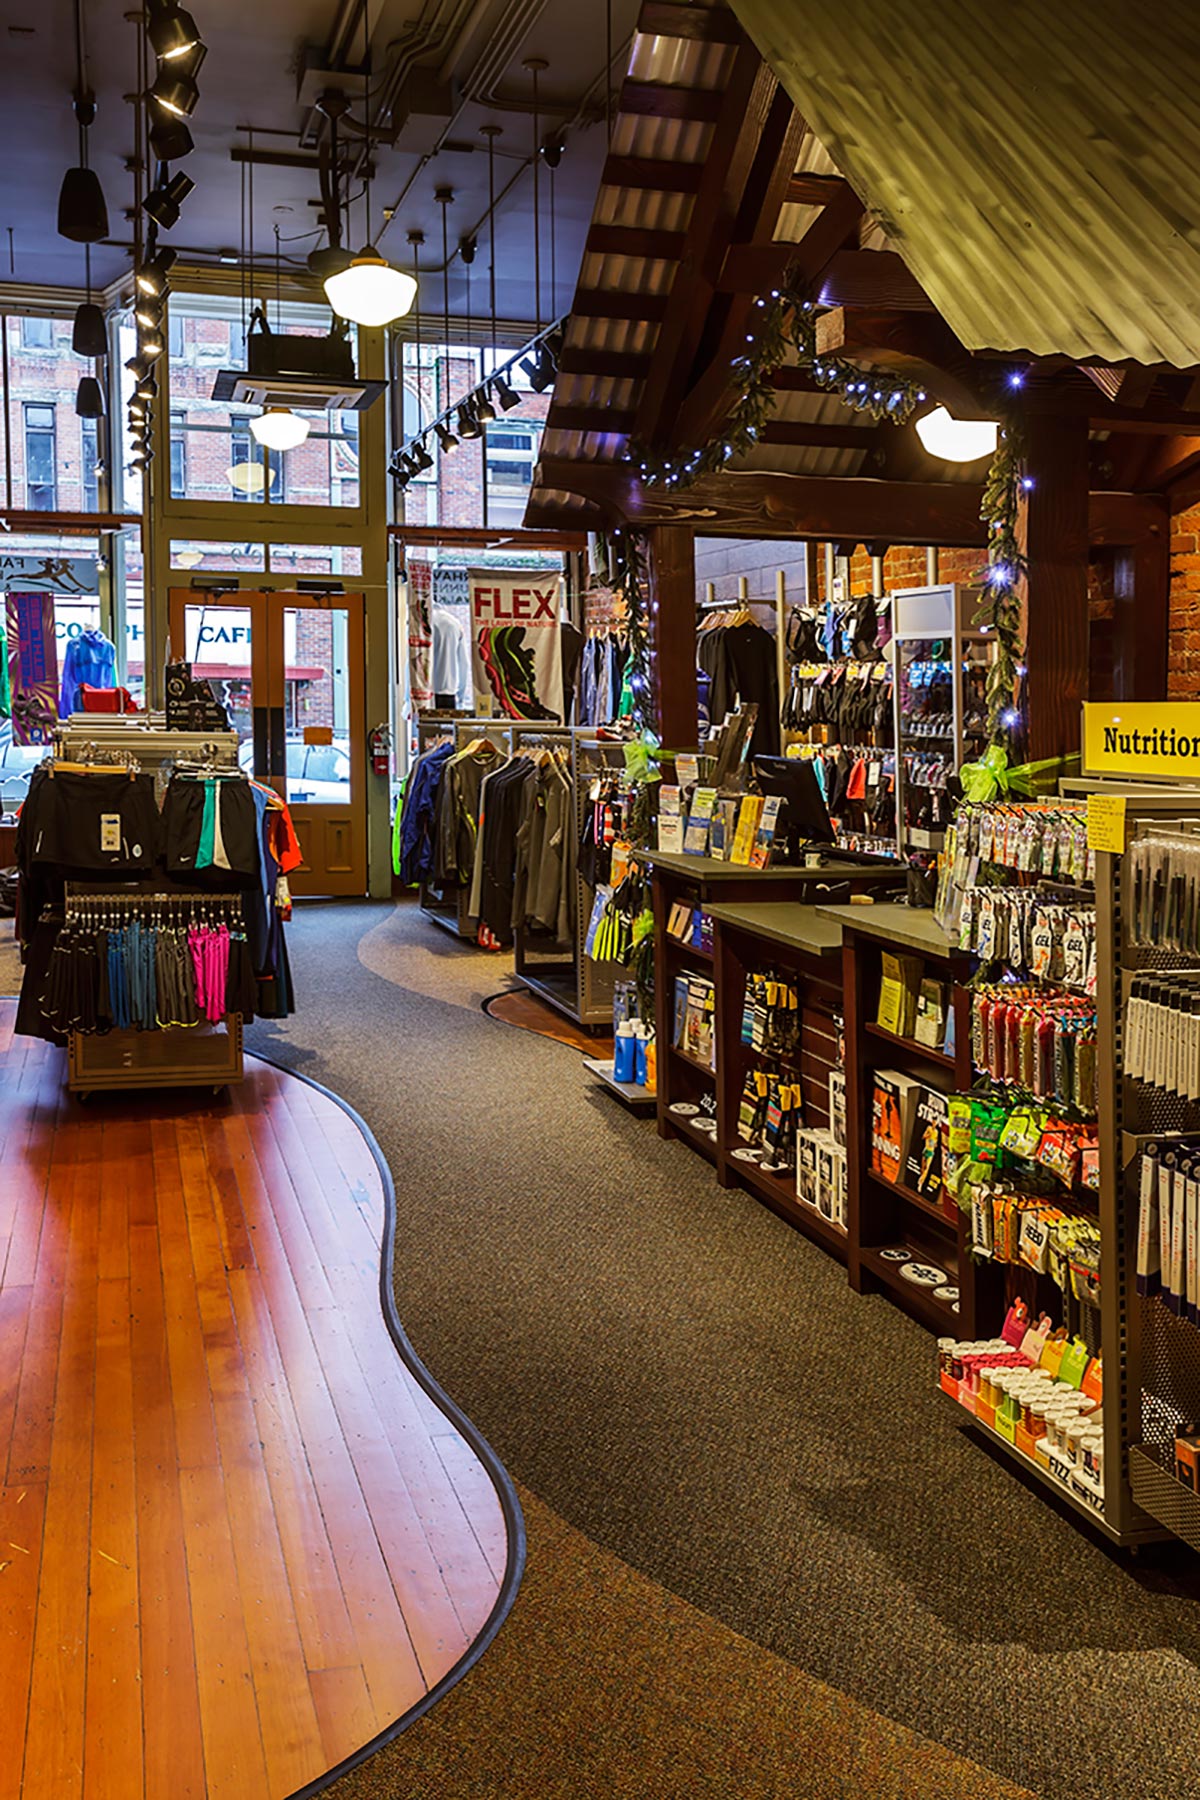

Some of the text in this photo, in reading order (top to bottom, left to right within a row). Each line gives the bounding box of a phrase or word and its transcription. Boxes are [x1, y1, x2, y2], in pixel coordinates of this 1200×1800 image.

[474, 587, 556, 620] FLEX
[1067, 937, 1083, 952] GEL
[1049, 1455, 1071, 1485] FIZZ
